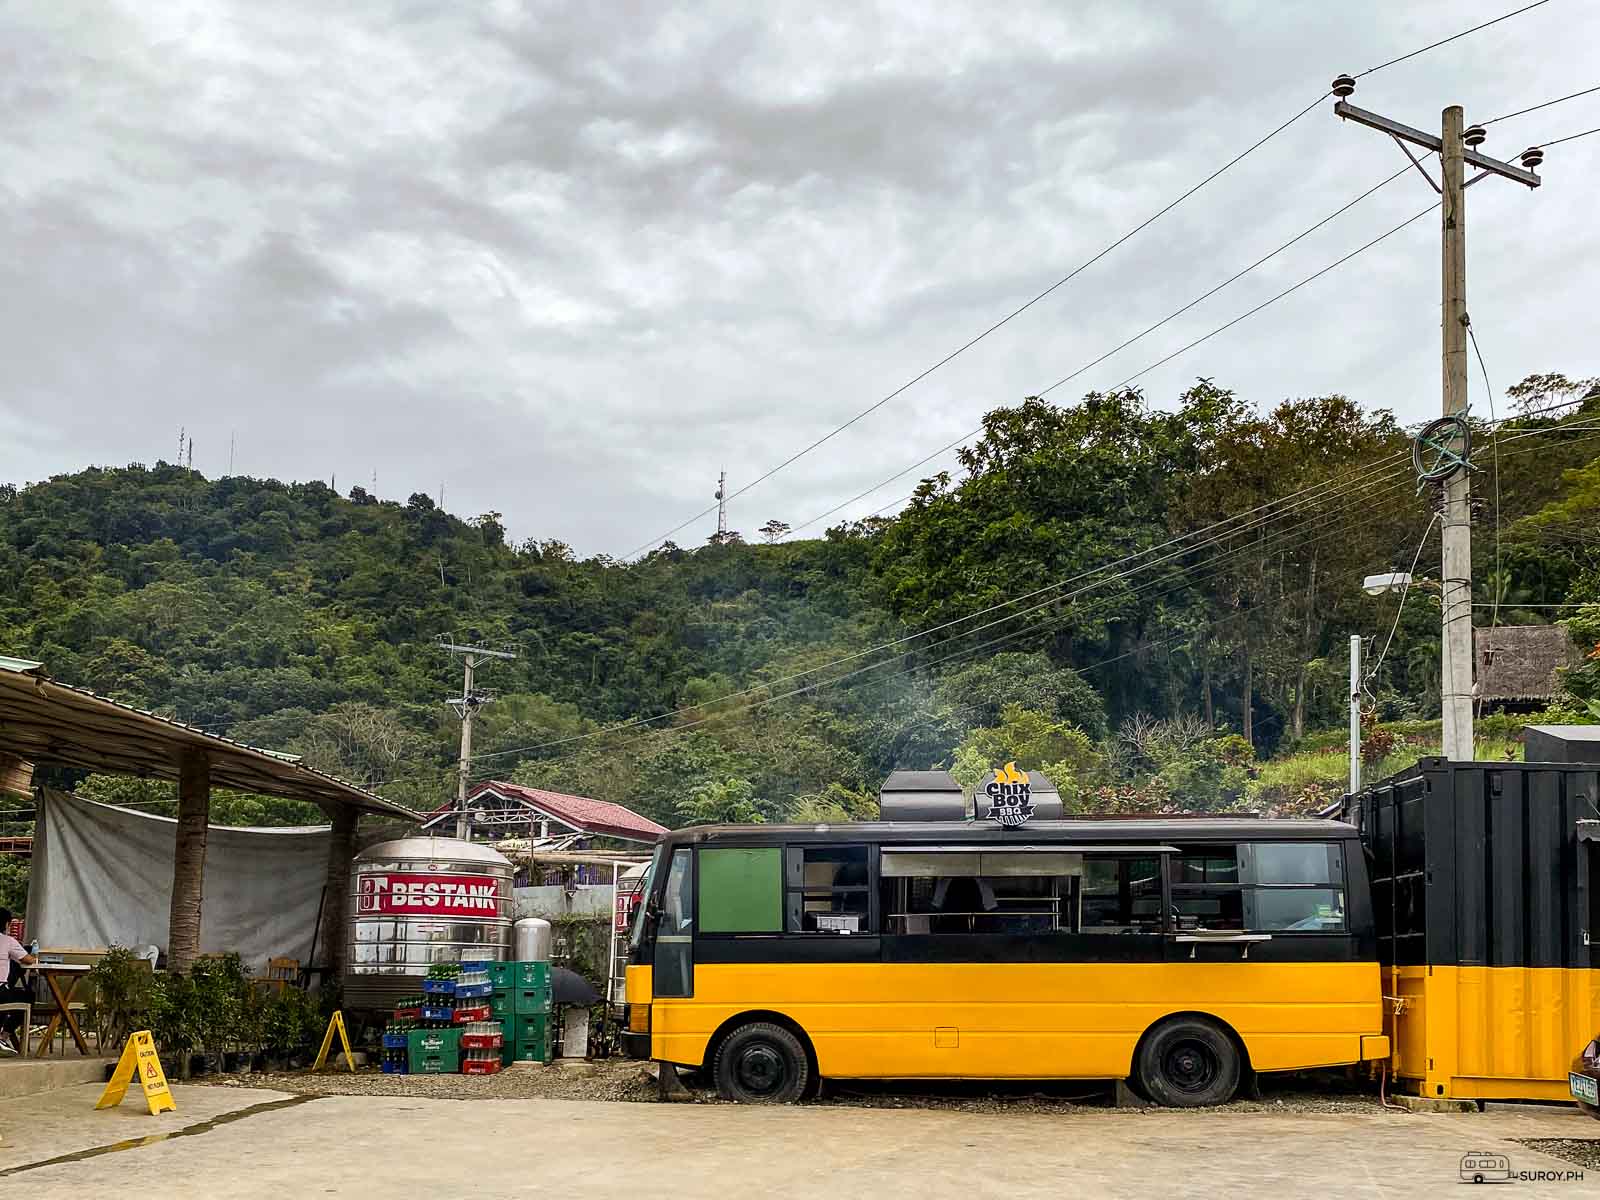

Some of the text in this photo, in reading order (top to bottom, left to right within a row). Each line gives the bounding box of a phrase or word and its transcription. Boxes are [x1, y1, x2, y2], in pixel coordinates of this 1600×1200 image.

[986, 783, 1030, 796] Chix
[994, 795, 1029, 807] Boy
[391, 882, 496, 910] BESTANK
